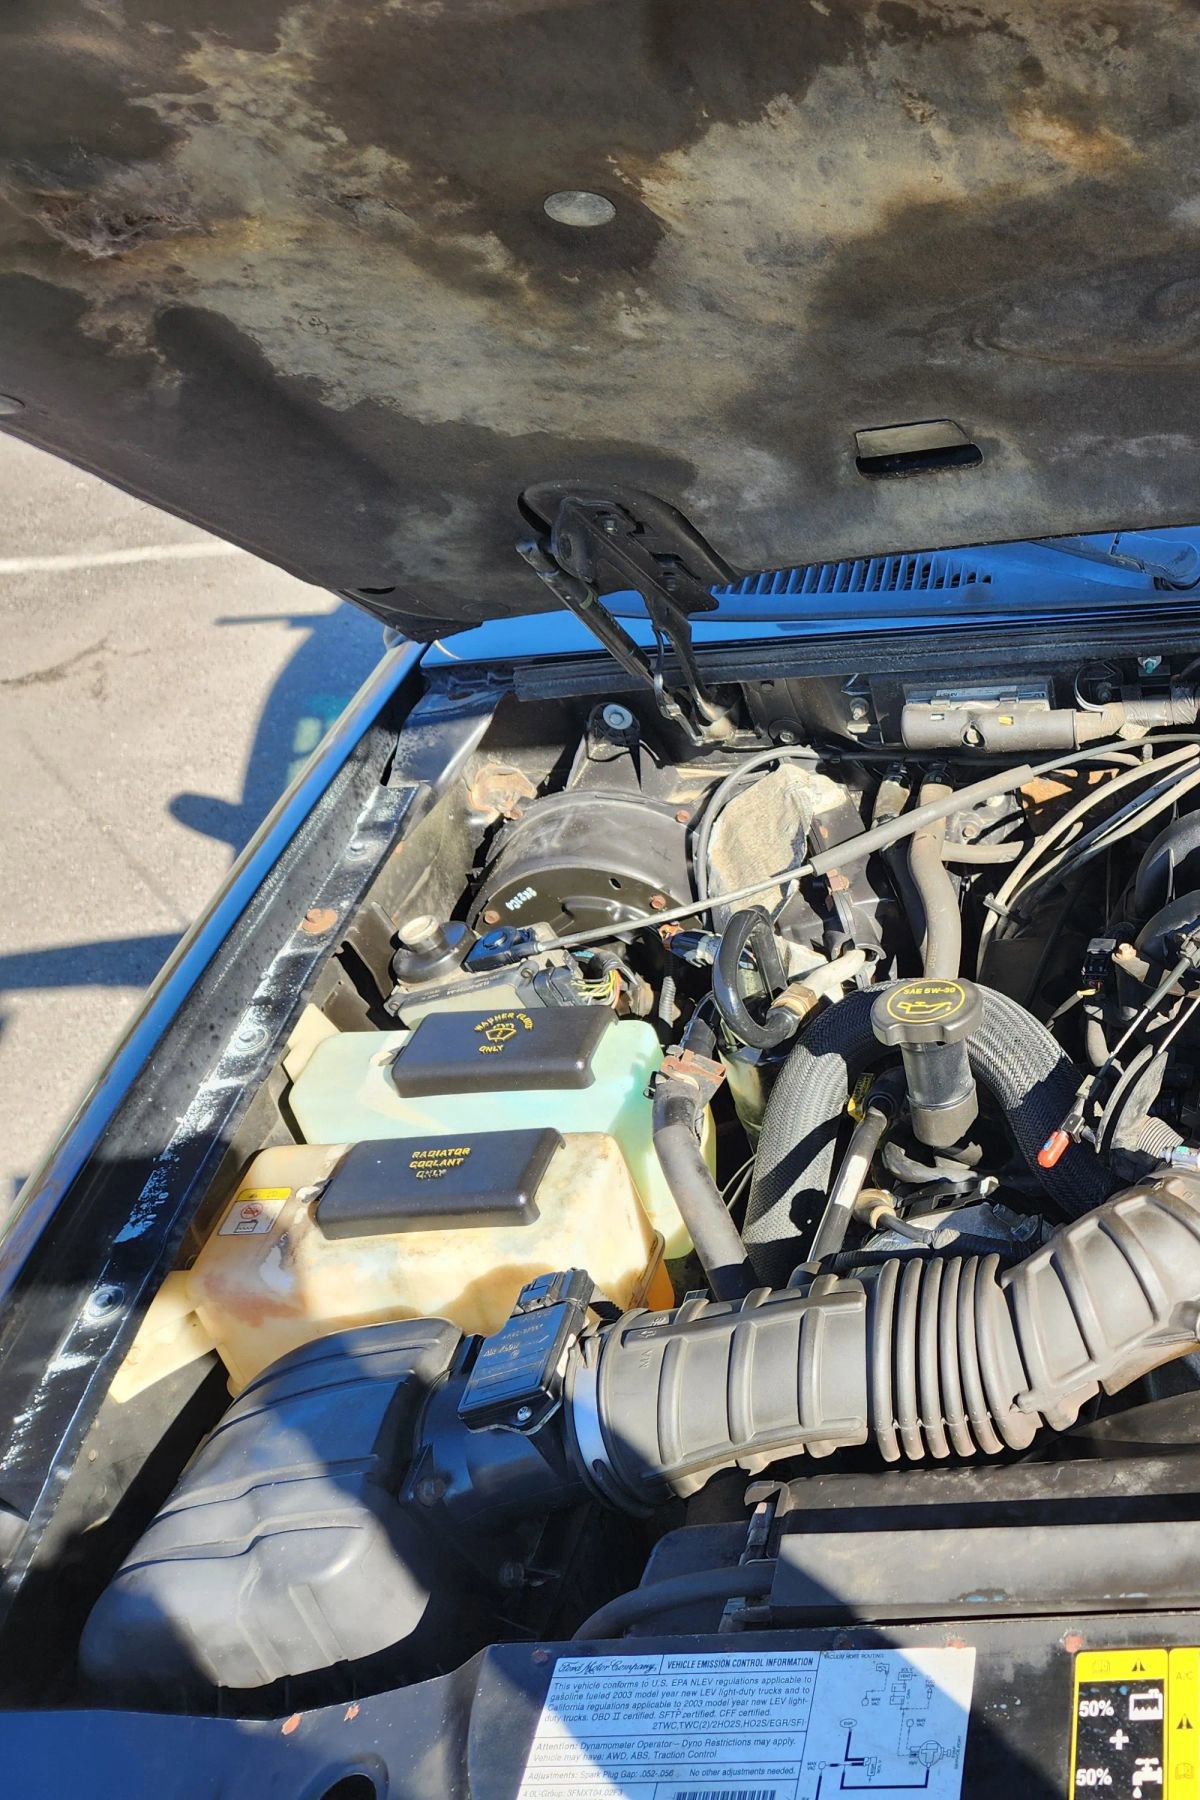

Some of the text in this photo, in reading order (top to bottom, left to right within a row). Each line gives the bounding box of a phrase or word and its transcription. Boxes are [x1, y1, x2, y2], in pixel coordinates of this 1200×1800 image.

[474, 1012, 515, 1032] WASHER
[478, 1044, 505, 1054] ONLY
[412, 1147, 471, 1159] RADIATOR
[409, 1158, 465, 1169] COOLANT
[416, 1169, 448, 1179] ONLY
[667, 1657, 814, 1670] VEHICLE EMISSION CONTROL INFORMATION
[554, 1676, 811, 1690] This vehicle conforms to U.S. EPA NLEV regulations applicable to
[550, 1686, 810, 1703] gasoline fueled 2003 model year new LEV light-duty trucks and to
[548, 1702, 585, 1712] California
[587, 1701, 631, 1712] regulations
[632, 1701, 672, 1711] applicable
[674, 1700, 682, 1709] to
[683, 1700, 703, 1708] 2003
[704, 1699, 729, 1708] model
[731, 1699, 750, 1709] year
[769, 1697, 788, 1706] LEV
[788, 1697, 808, 1707] light-
[1078, 1699, 1115, 1717] 50%
[591, 1712, 611, 1721] OBD
[613, 1712, 622, 1721] II
[623, 1711, 656, 1721] certified.
[658, 1711, 682, 1720] SFTP
[719, 1709, 736, 1718] CFF
[738, 1708, 772, 1717] certified.
[535, 1737, 796, 1751] Attention: Dynamometer Dyno Restrictions may apply.
[564, 1754, 580, 1763] may
[606, 1752, 629, 1762] AWD,
[654, 1750, 686, 1759] Traction
[687, 1749, 718, 1759] Control.
[528, 1771, 576, 1781] Adjustments:
[603, 1769, 620, 1780] Plug
[620, 1769, 638, 1780] Gap:
[689, 1768, 700, 1777] No
[701, 1768, 720, 1776] other
[722, 1767, 765, 1778] adjustments
[767, 1766, 795, 1775] needed.
[1076, 1768, 1113, 1786] 50%
